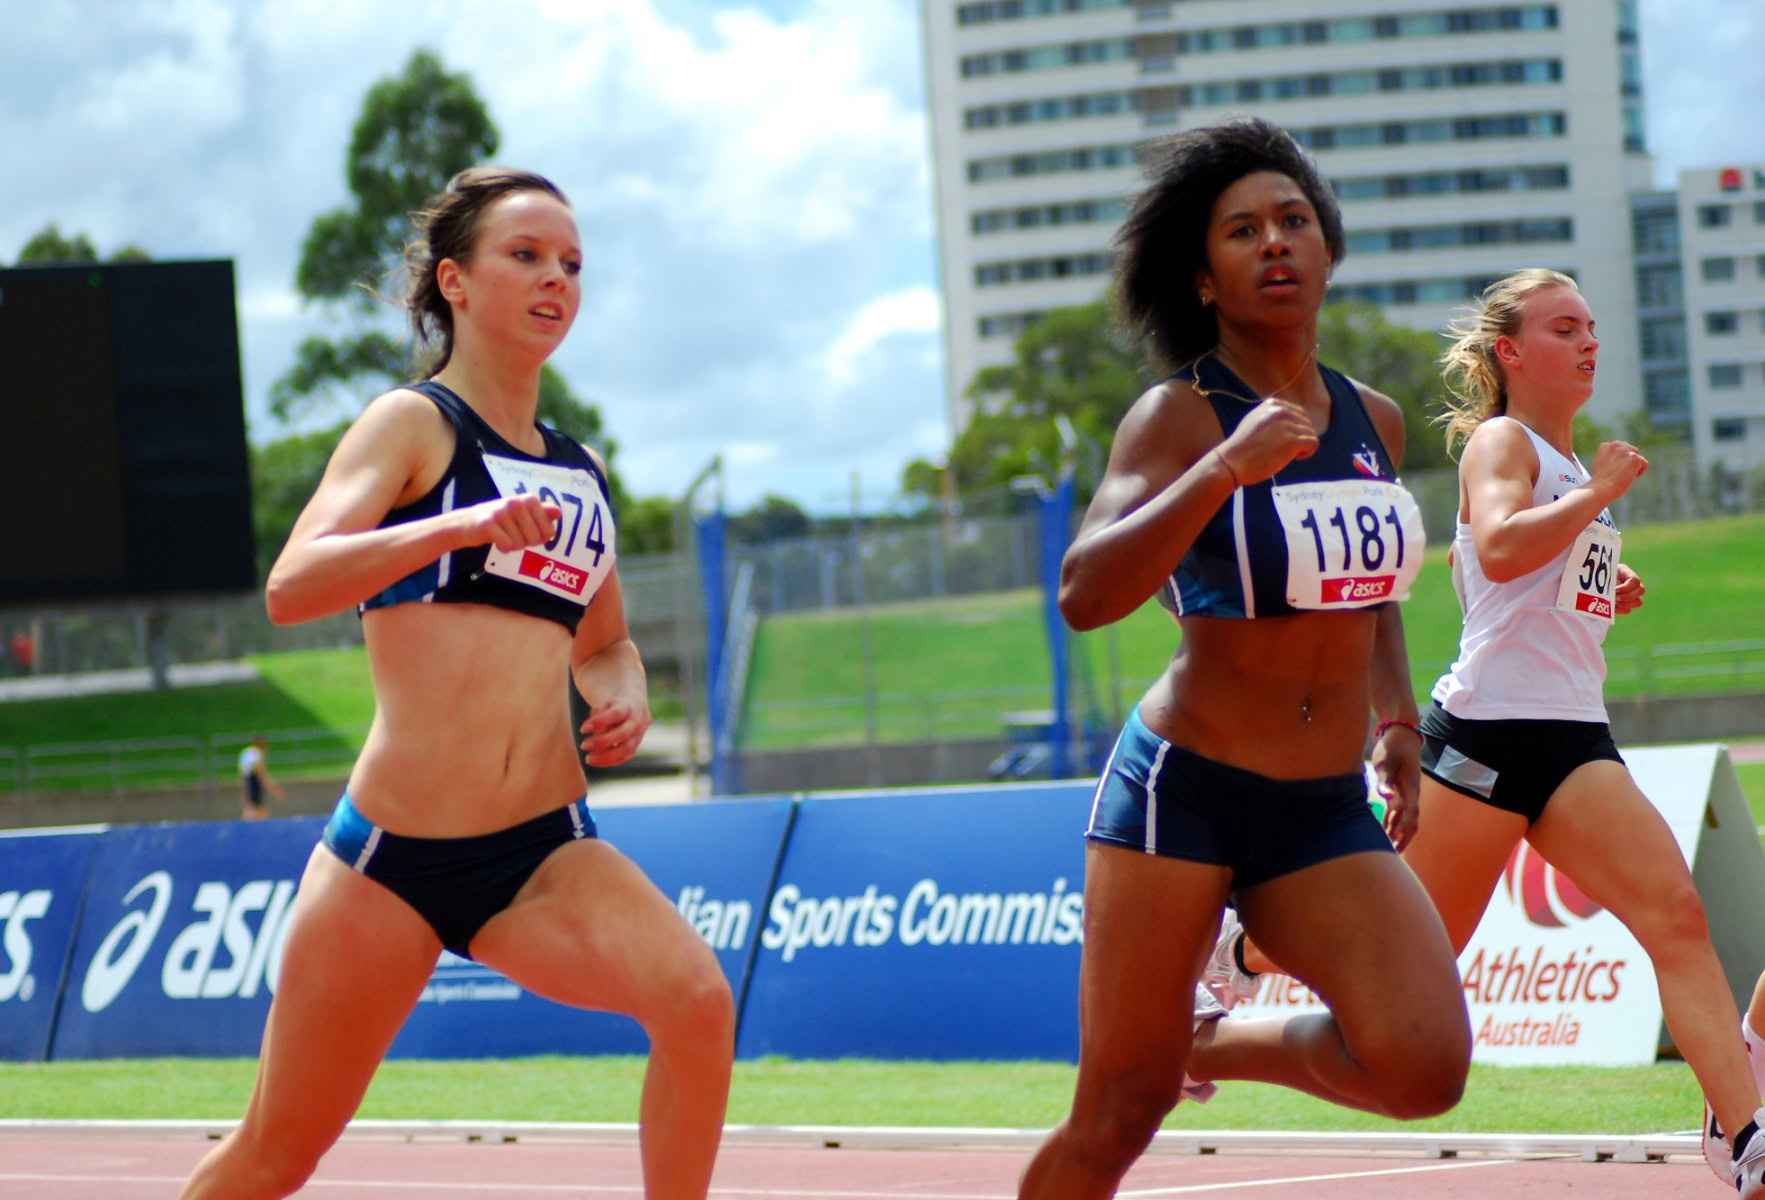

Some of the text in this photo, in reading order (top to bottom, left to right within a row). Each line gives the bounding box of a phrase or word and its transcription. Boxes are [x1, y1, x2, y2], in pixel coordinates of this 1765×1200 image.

[514, 482, 605, 568] 074
[1300, 505, 1405, 573] 1181
[550, 565, 580, 590] asics
[1353, 581, 1387, 598] asics
[1578, 542, 1613, 595] 561
[762, 883, 898, 963] Sports
[898, 876, 1085, 947] Commis
[1463, 945, 1626, 1003] Athletics
[1475, 1013, 1580, 1047] Australia
